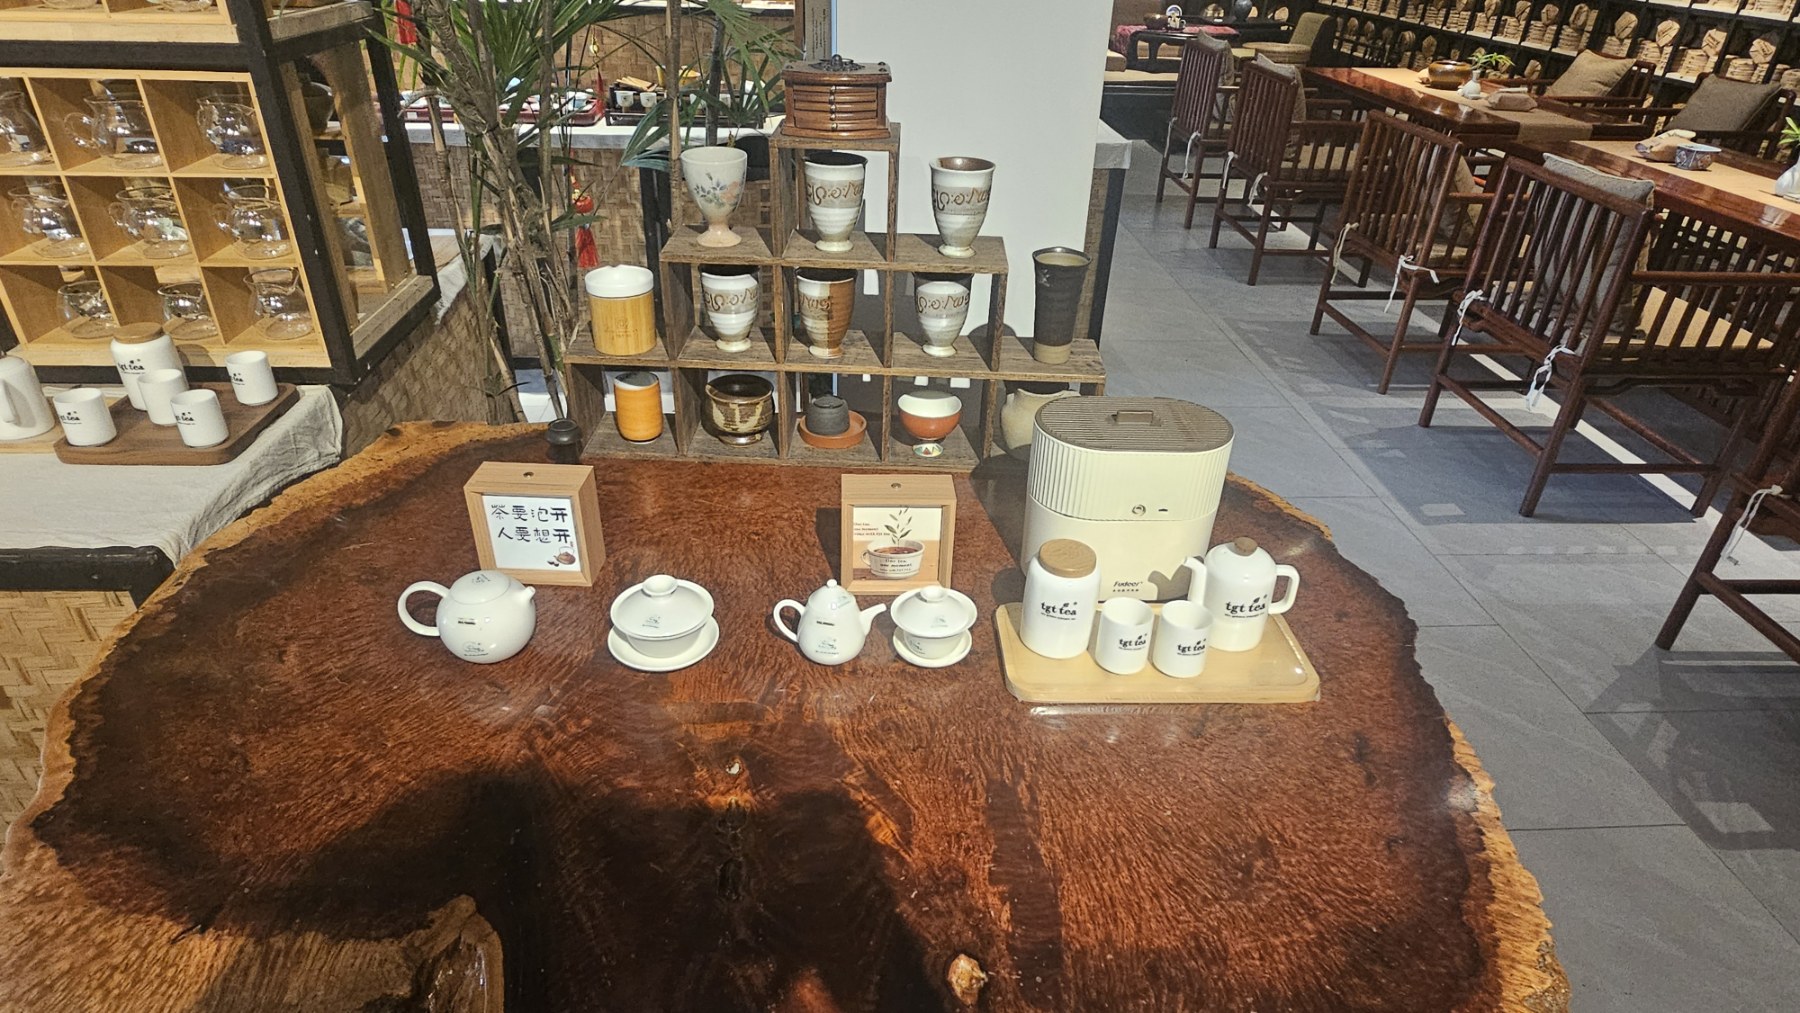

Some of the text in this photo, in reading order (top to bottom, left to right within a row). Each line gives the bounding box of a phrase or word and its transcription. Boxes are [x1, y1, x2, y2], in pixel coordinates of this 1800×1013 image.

[491, 504, 568, 522] 茶要泡开
[497, 526, 571, 543] 人要想开
[1041, 601, 1058, 615] tgt
[1059, 607, 1077, 616] tea
[1225, 601, 1266, 615] tgt tea
[1119, 638, 1146, 648] tgt tea
[1177, 643, 1205, 653] tgt tea
